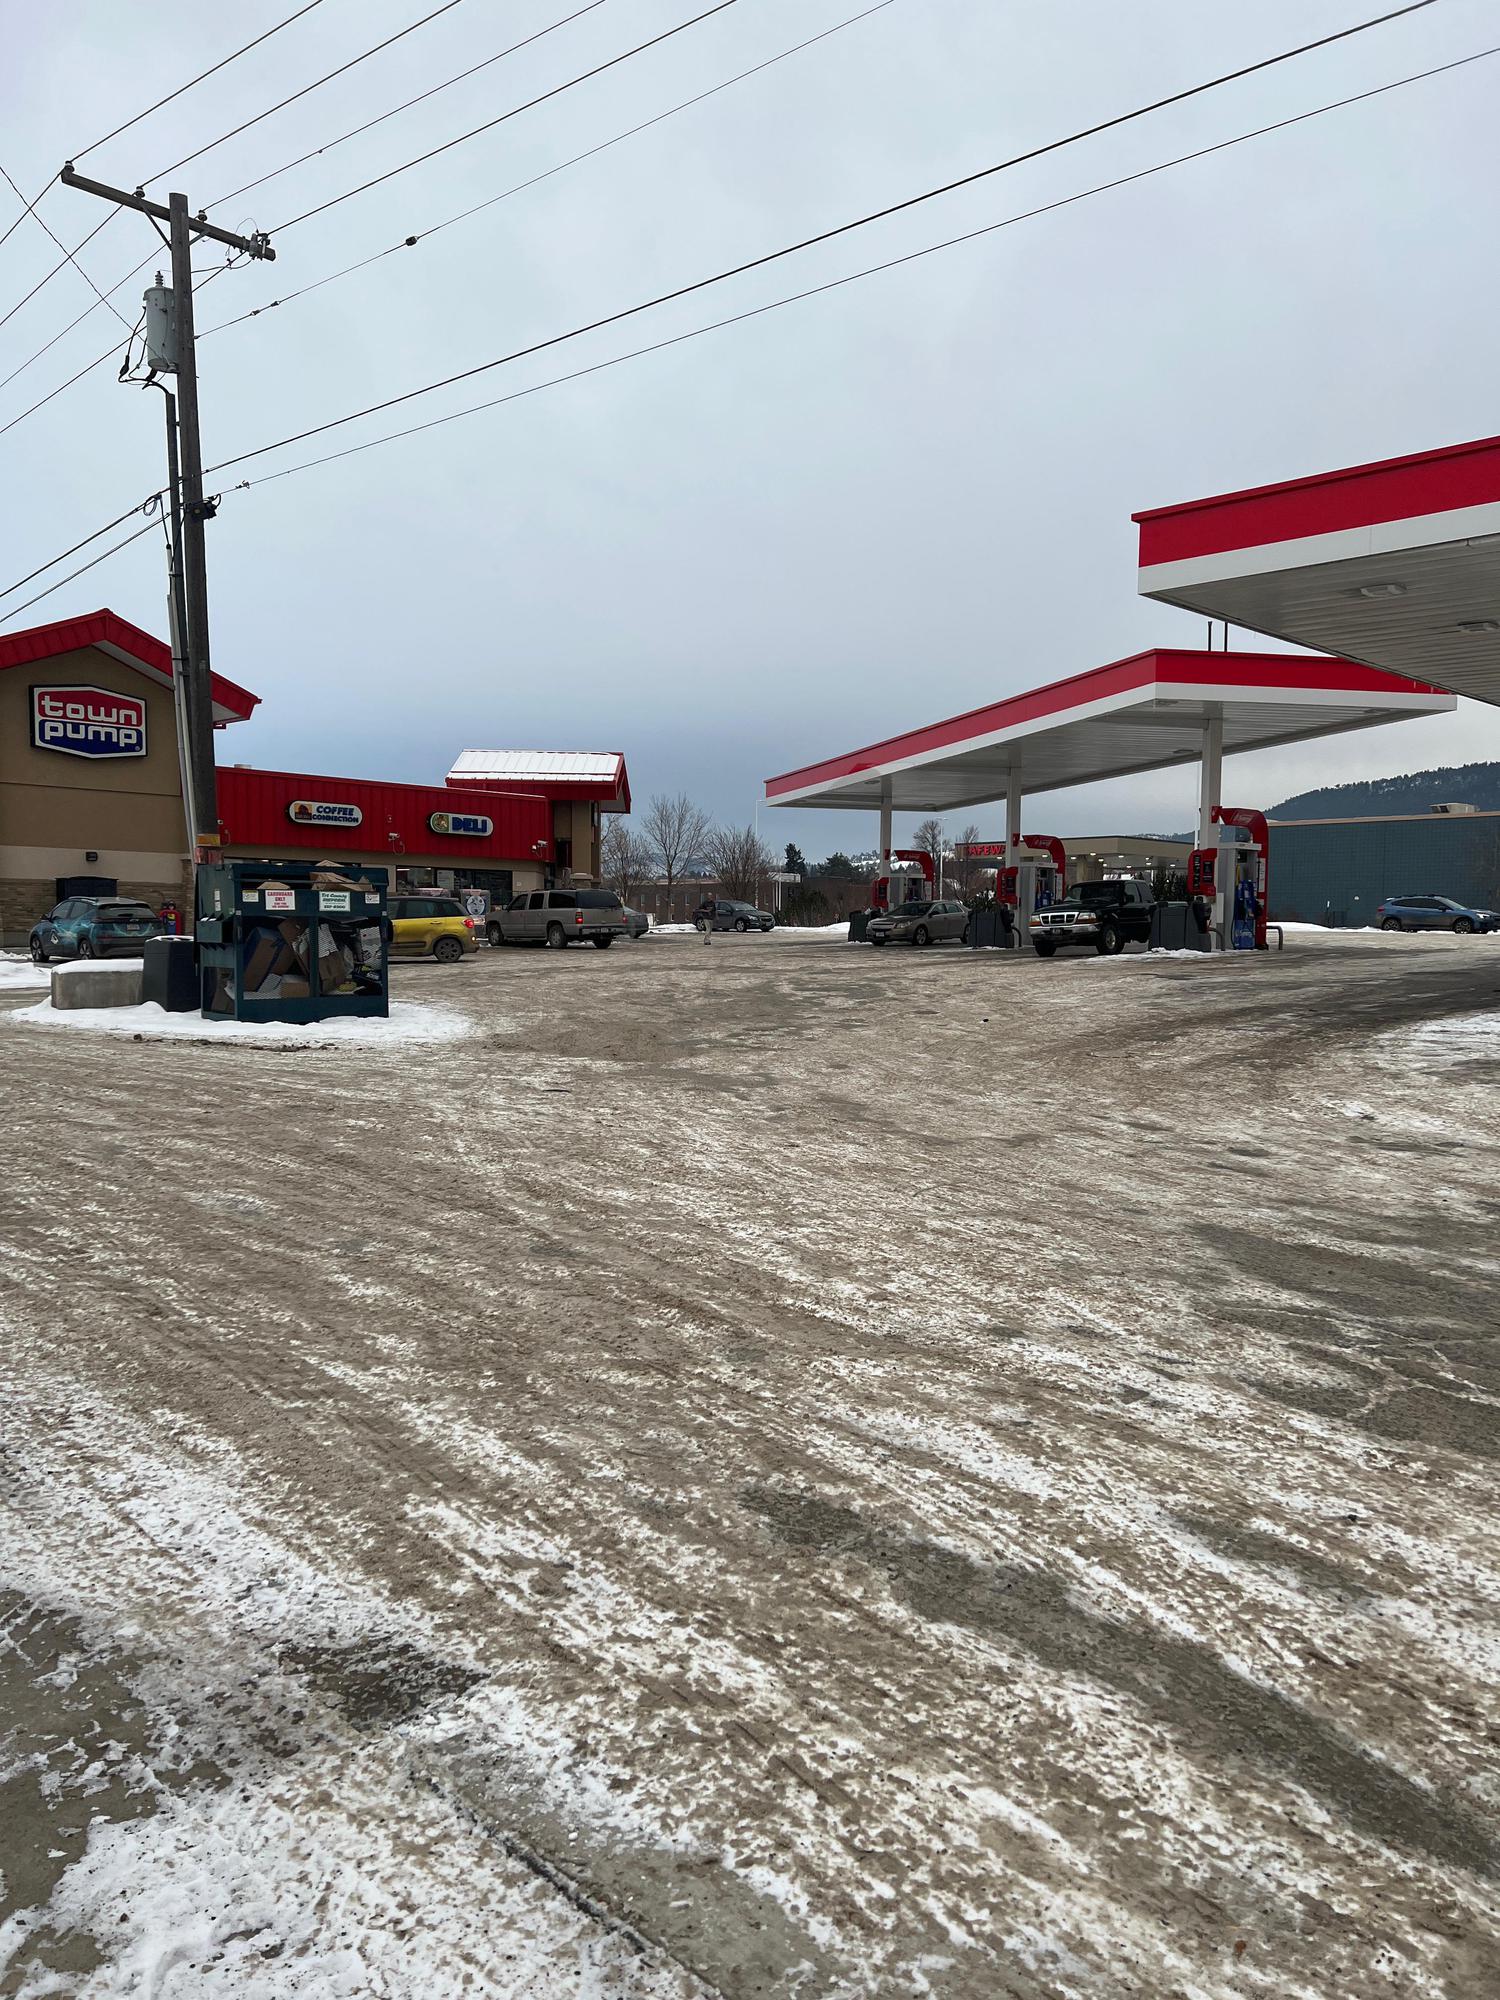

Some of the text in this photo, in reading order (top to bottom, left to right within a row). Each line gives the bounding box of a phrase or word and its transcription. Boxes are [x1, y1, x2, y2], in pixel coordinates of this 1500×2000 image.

[41, 695, 137, 725] town
[44, 721, 137, 747] pump
[312, 814, 359, 823] CONNECTION
[316, 805, 355, 816] COFFEE
[452, 816, 487, 833] DELI
